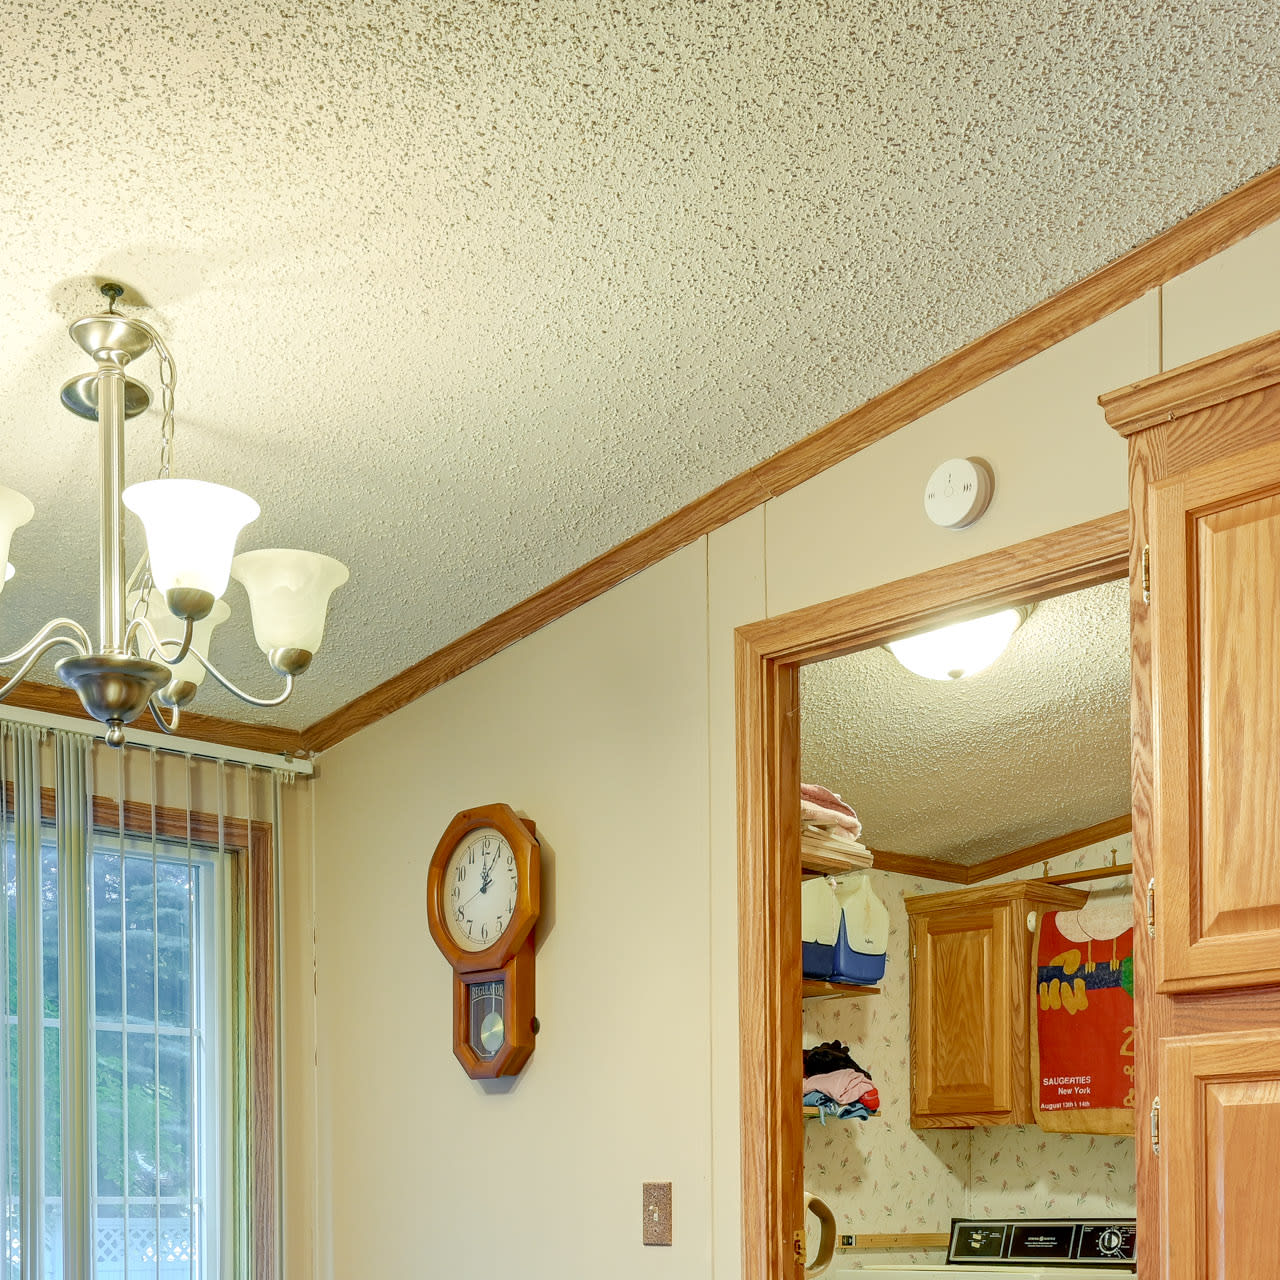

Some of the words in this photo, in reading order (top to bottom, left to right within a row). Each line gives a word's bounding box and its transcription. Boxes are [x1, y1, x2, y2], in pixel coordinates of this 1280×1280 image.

[468, 846, 475, 864] 11
[456, 865, 466, 882] 10
[451, 886, 461, 900] 9
[456, 904, 465, 921] 8
[466, 919, 473, 935] 7
[481, 922, 488, 939] 6
[471, 984, 504, 999] REGULATOR
[1043, 1076, 1091, 1085] SAUGERTIES
[1058, 1087, 1073, 1095] New
